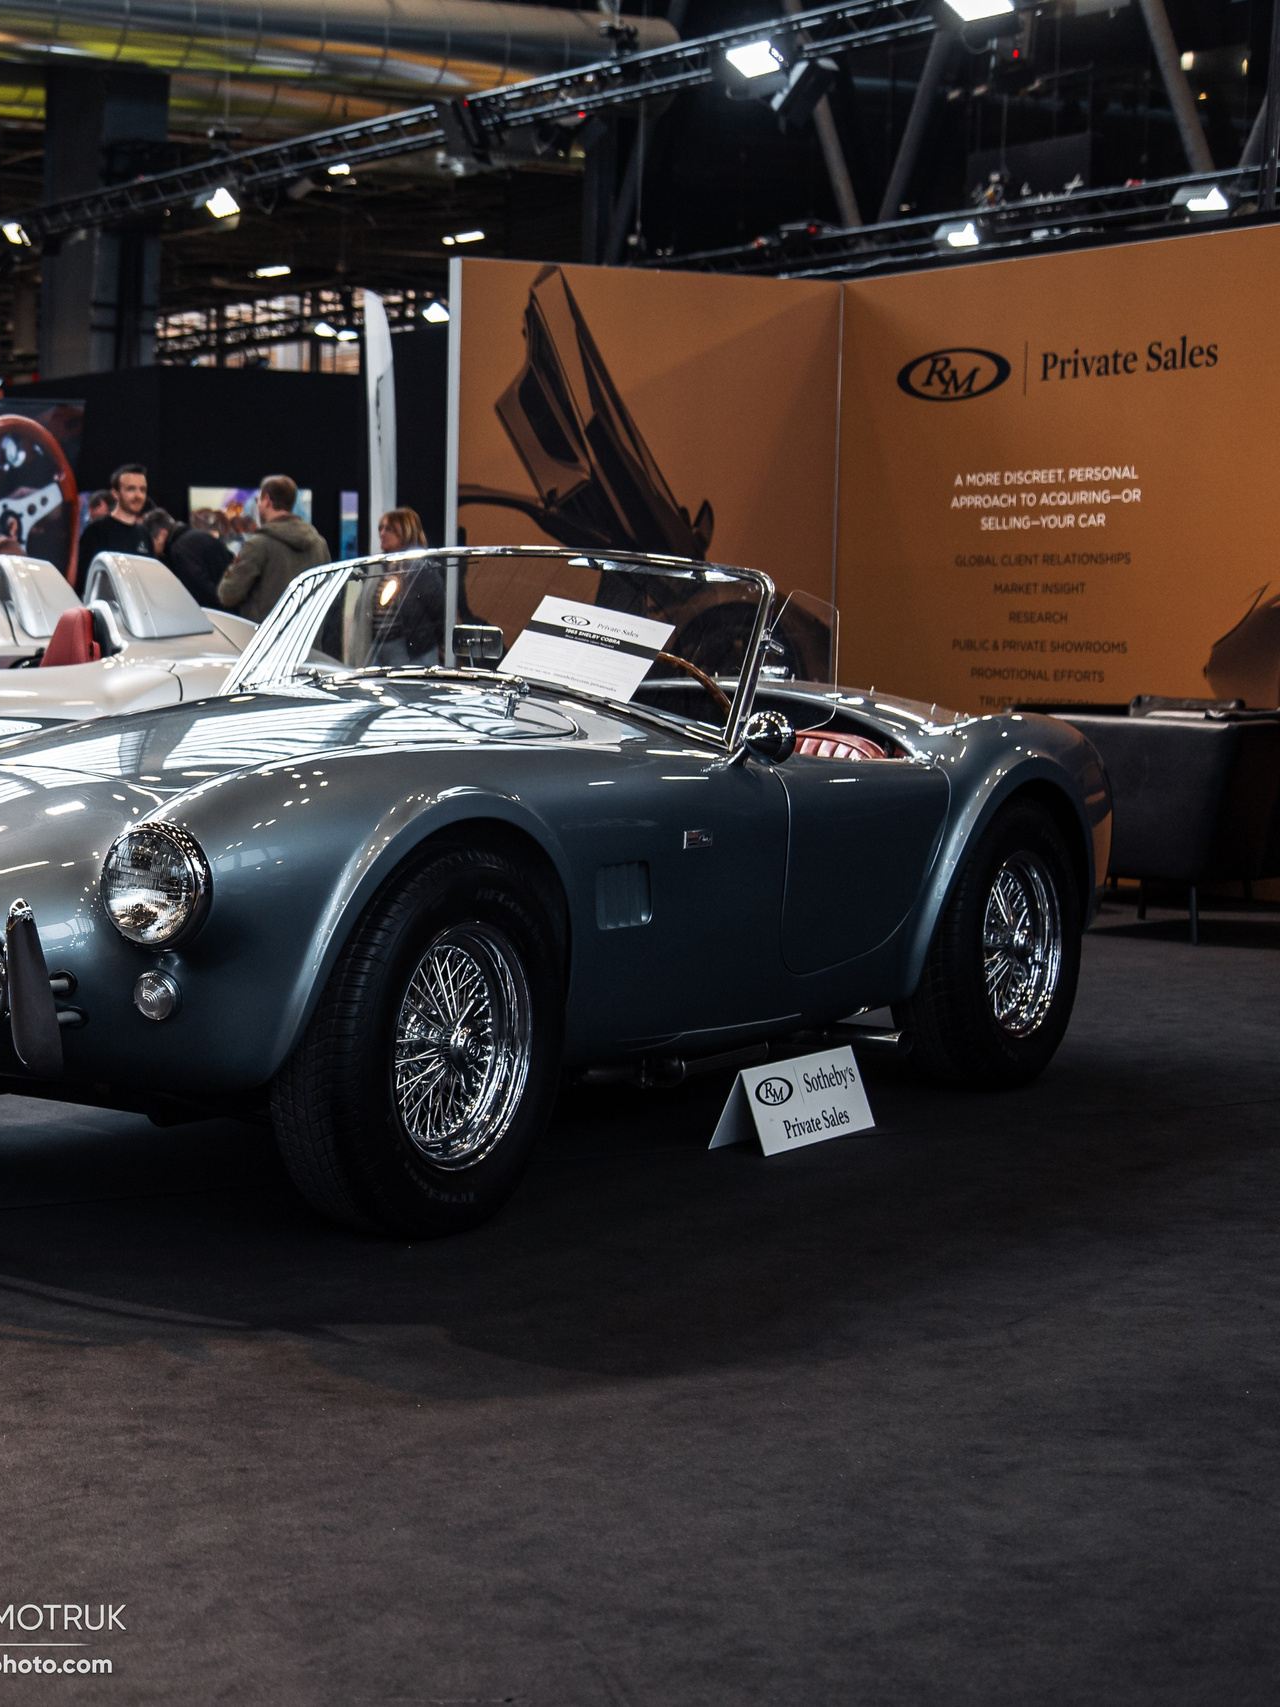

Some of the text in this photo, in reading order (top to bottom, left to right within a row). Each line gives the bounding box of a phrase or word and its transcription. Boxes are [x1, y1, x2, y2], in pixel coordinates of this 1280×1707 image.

[1040, 348, 1138, 381] Private
[1146, 335, 1219, 372] Sales
[954, 465, 1139, 487] A MORE DISCREET, PERSONAL
[950, 493, 1017, 509] APPROACH
[1020, 493, 1036, 507] TO
[1077, 512, 1106, 528] CAR
[955, 551, 1132, 567] GLOBAL CLIENT RELATIONSHIPS
[994, 582, 1086, 595] MARKET INSIGHT
[1009, 611, 1068, 624] RESEARCH
[578, 630, 600, 640] SHELBY
[600, 636, 621, 646] COBRA
[597, 622, 621, 633] Private
[622, 629, 639, 638] Sales
[952, 638, 1128, 655] PUBLIC & PRIVATE SHOWROOMS
[970, 666, 1105, 683] PROMOTIONAL EFFORTS
[980, 695, 1013, 707] TRUST
[803, 1064, 855, 1093] Sotheby's
[783, 1107, 851, 1139] Private Sales
